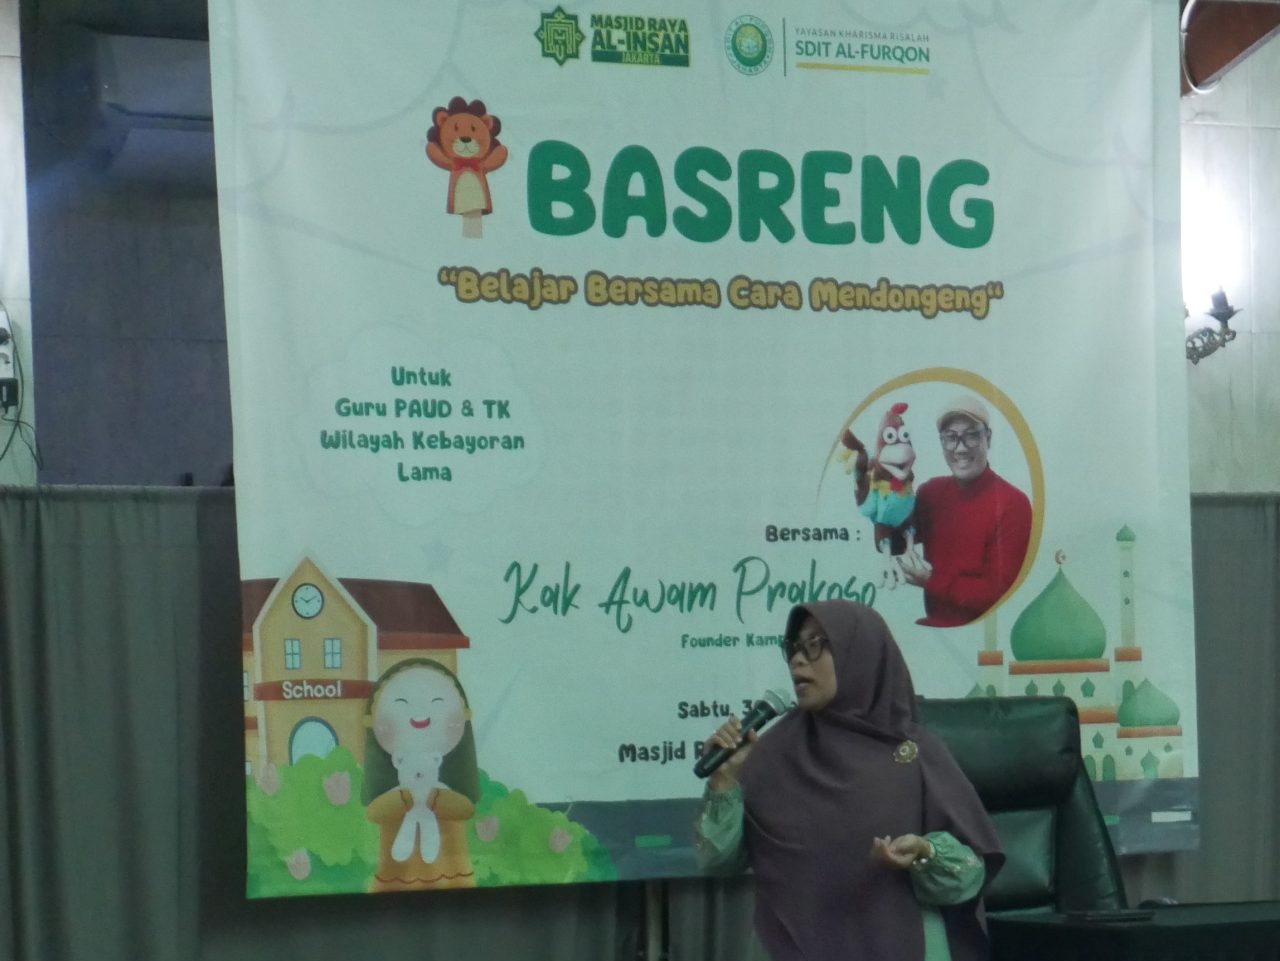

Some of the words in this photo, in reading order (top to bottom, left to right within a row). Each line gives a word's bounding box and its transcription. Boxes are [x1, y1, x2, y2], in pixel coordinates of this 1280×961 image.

[591, 14, 645, 31] MASJID
[647, 17, 688, 33] RAYA
[794, 27, 836, 38] YAYASAN
[592, 29, 689, 55] AL-INSAN
[795, 40, 832, 57] SDIT
[835, 42, 930, 63] AL-FURQON
[622, 52, 661, 64] JAKARTA
[527, 140, 994, 248] BASRENG
[584, 270, 721, 308] Bersama
[727, 275, 802, 310] Cara
[391, 366, 452, 387] Untuk
[335, 397, 387, 417] Guru
[395, 399, 452, 418] PAUD
[461, 400, 474, 417] &
[482, 400, 511, 418] TK
[320, 430, 405, 453] Wilayah
[412, 430, 525, 454] Kebayoran
[397, 462, 452, 482] Lama
[766, 524, 849, 543] Bersama
[498, 560, 582, 624] Kak
[598, 565, 717, 633] Awam
[681, 633, 740, 648] Founder
[282, 680, 342, 698] School
[618, 741, 686, 765] Masjid
